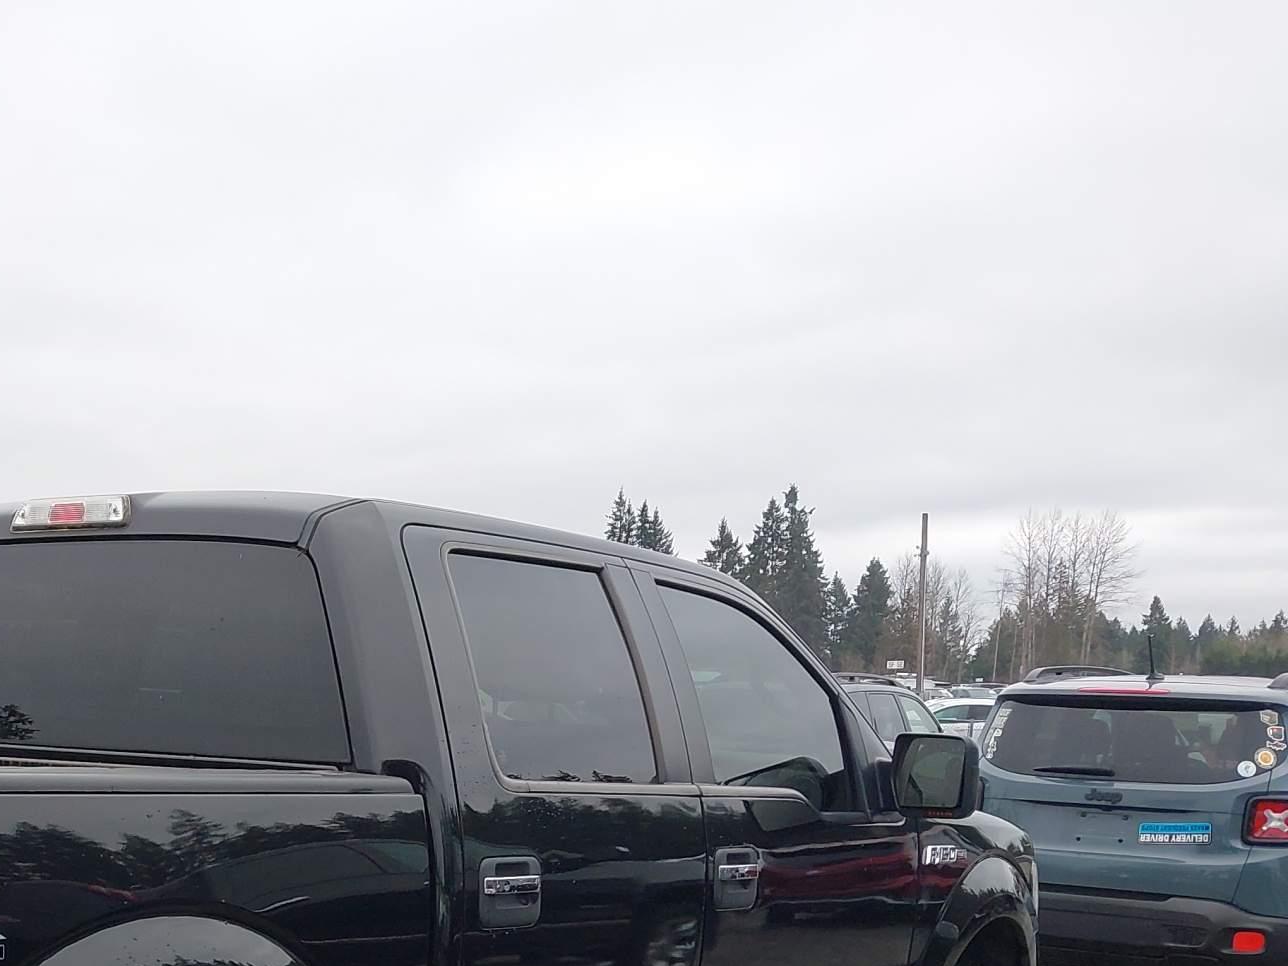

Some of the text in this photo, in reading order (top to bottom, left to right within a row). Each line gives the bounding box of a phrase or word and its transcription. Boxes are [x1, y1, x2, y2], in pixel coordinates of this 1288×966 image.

[1084, 788, 1121, 805] Jeep
[1140, 833, 1209, 843] DELIVERY DRIVER
